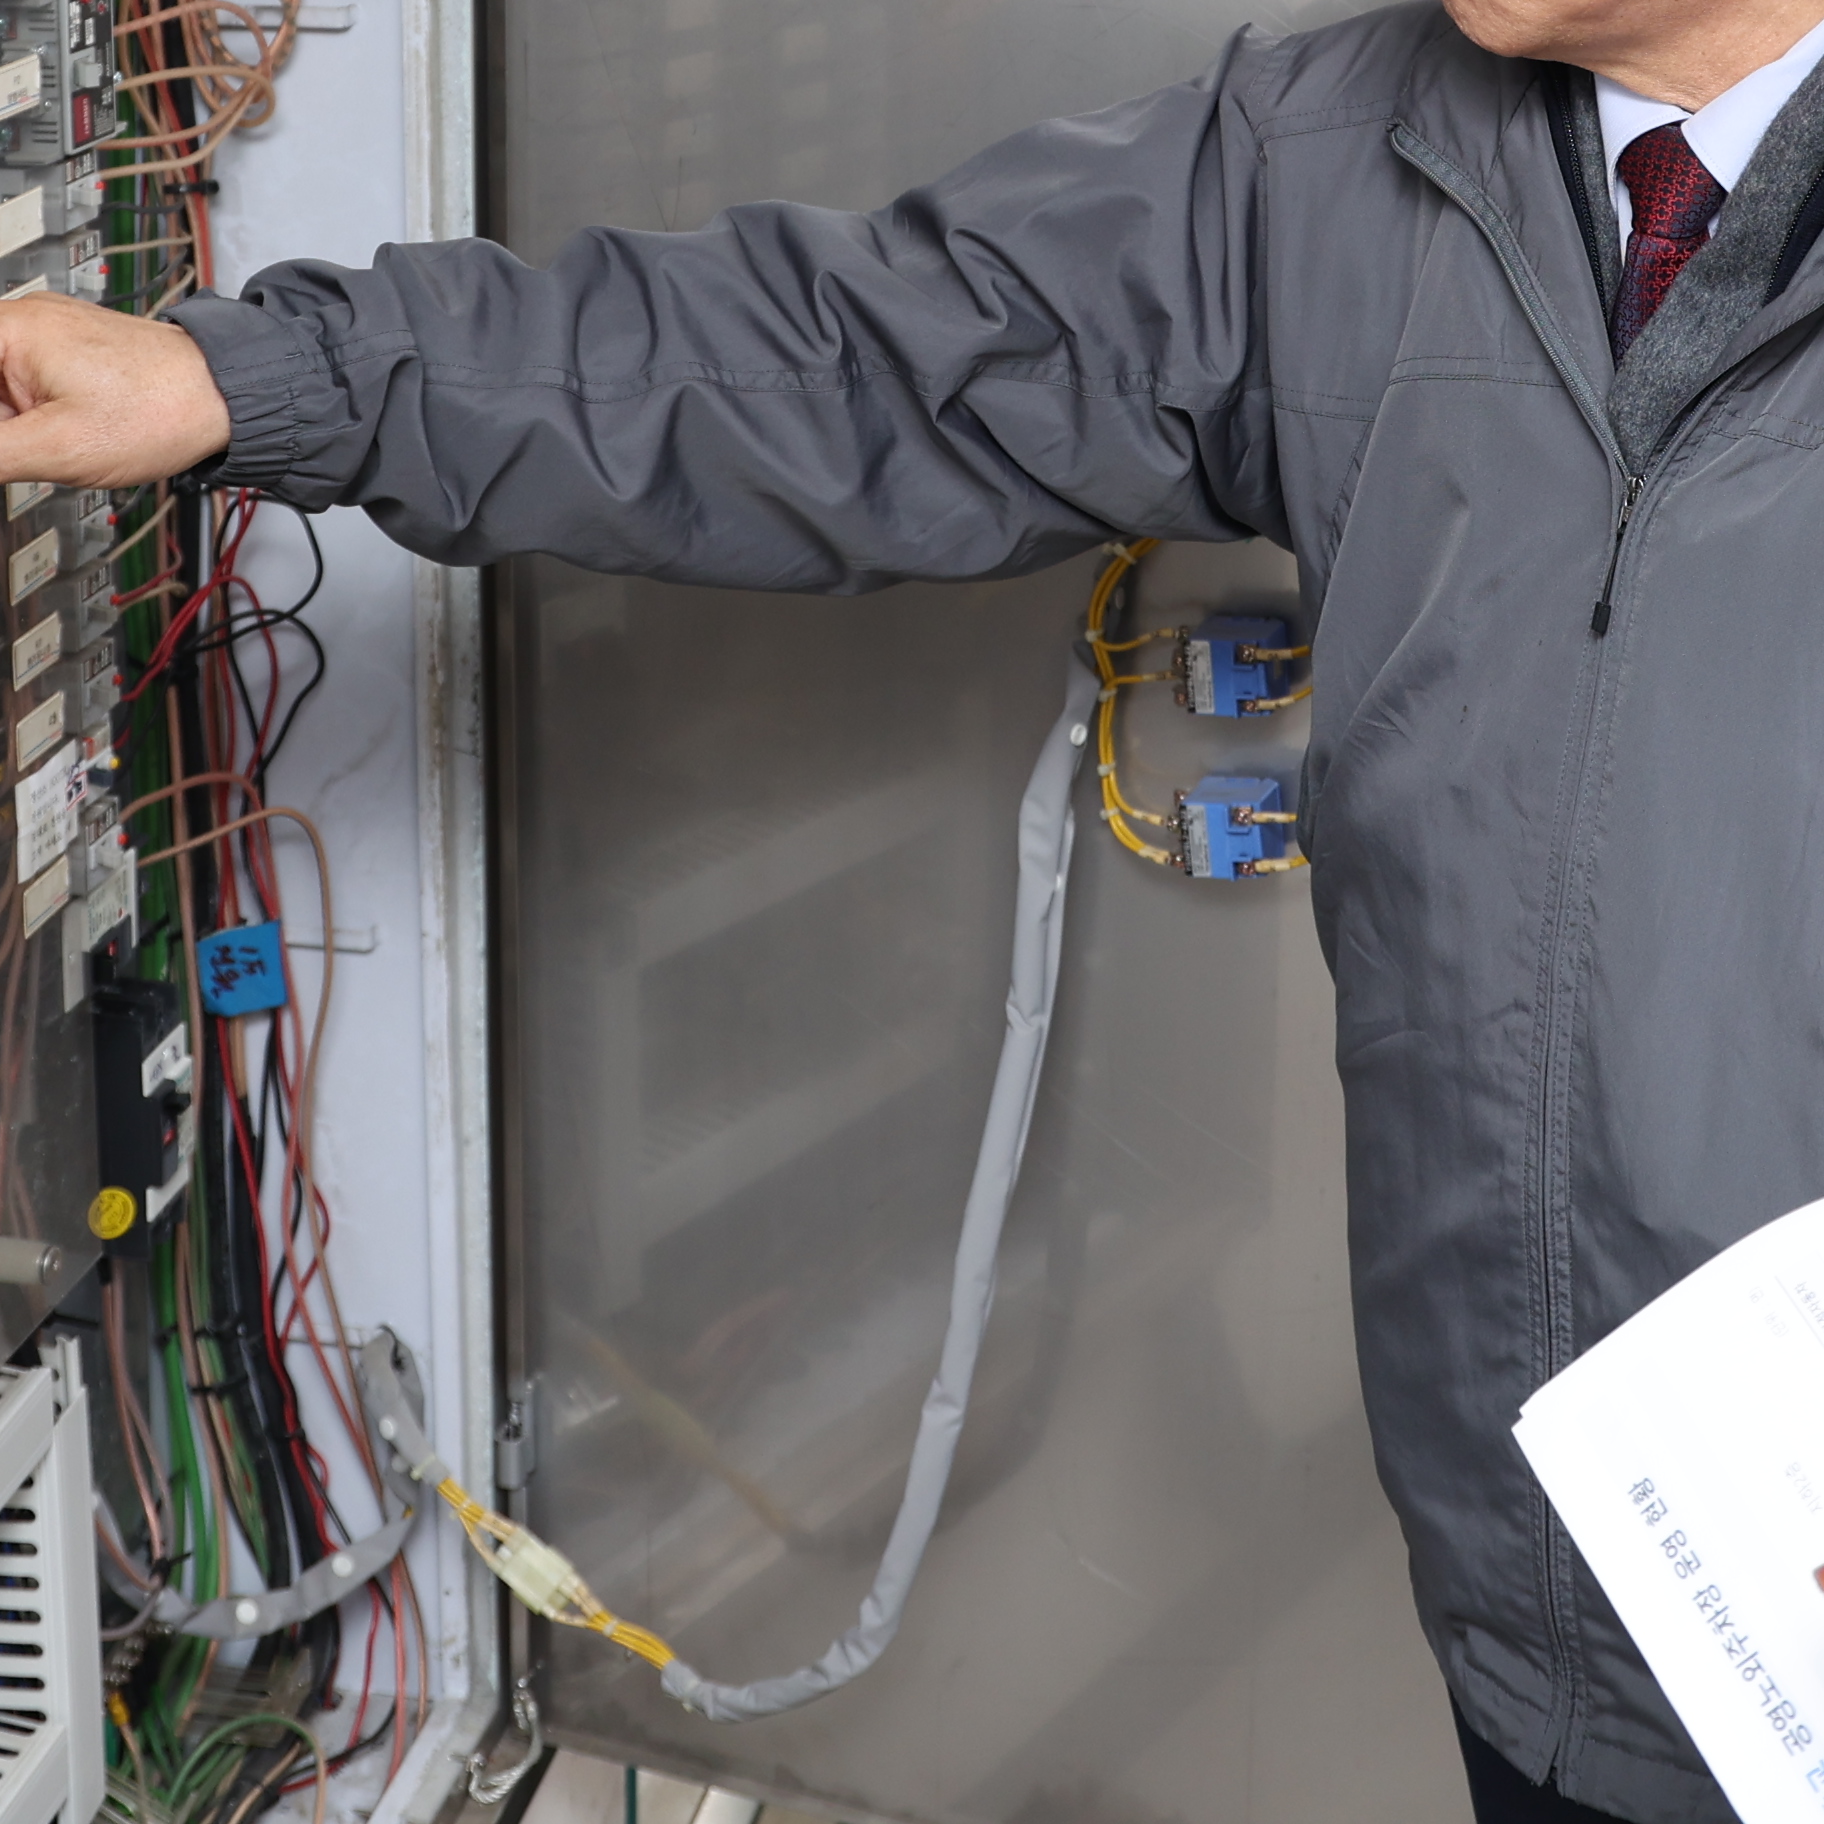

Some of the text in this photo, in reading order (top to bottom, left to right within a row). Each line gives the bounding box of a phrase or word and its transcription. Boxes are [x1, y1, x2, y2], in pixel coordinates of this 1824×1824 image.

[1624, 1474, 1672, 1528] 현황
[1656, 1527, 1705, 1581] 운영
[1690, 1581, 1818, 1756] 공영노외주차장
